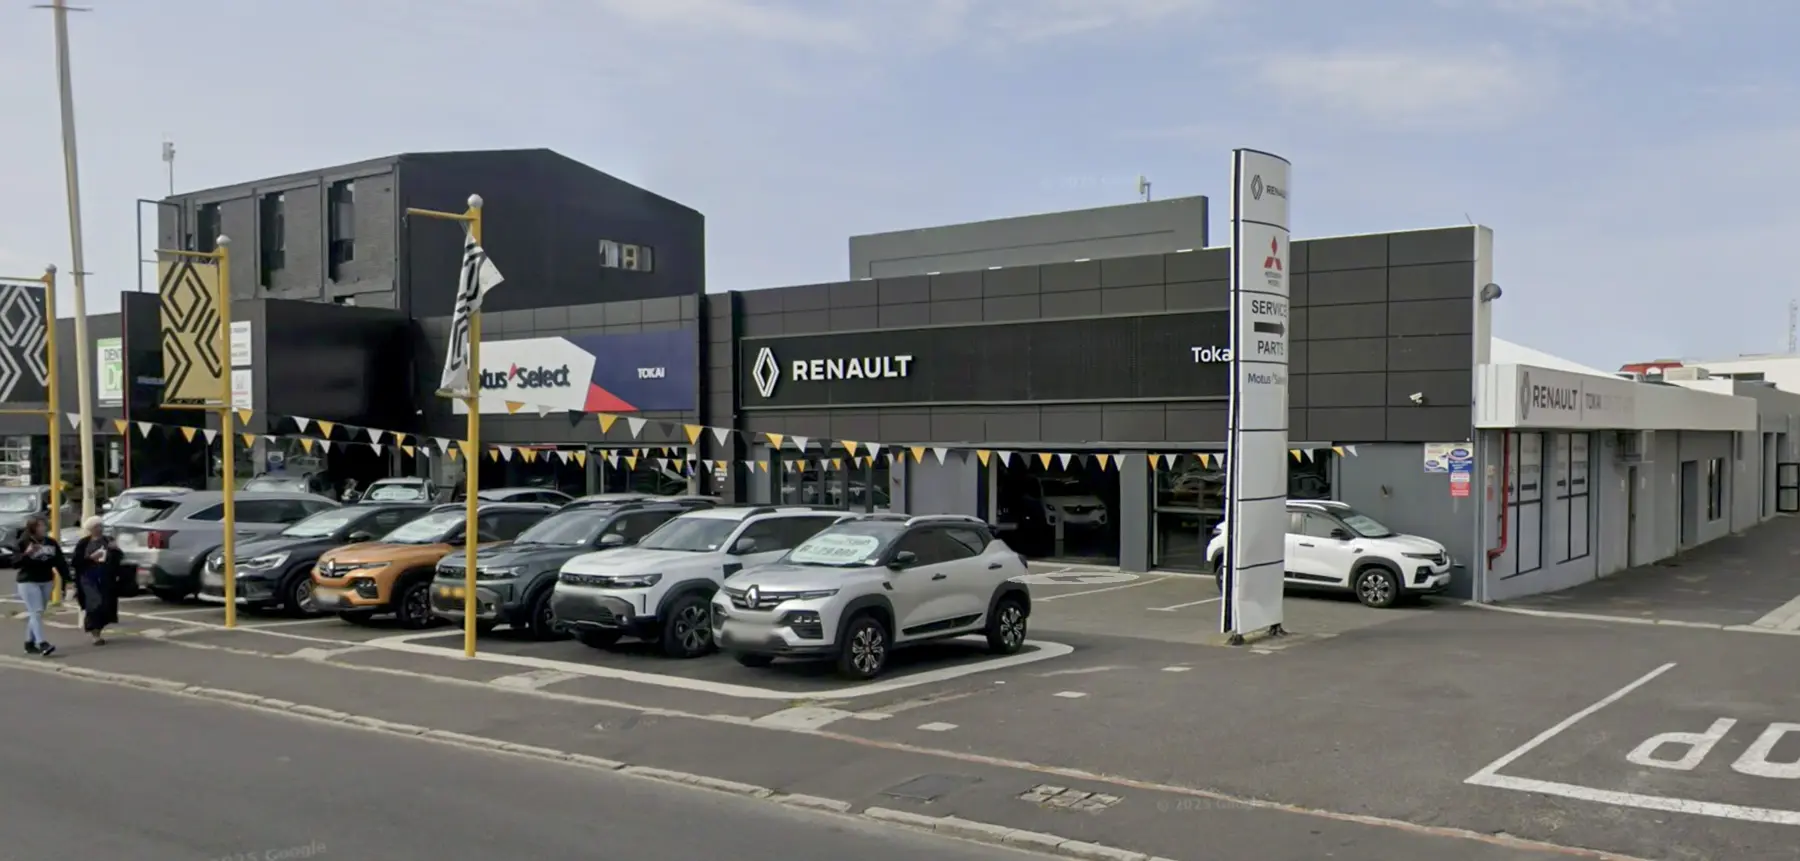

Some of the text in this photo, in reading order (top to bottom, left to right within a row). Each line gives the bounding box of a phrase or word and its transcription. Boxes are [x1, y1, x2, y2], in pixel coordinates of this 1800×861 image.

[1191, 345, 1231, 363] Toka
[516, 364, 571, 389] Select
[637, 367, 665, 379] TOKAI
[792, 355, 912, 381] RENAULT
[1532, 384, 1578, 411] RENAULT
